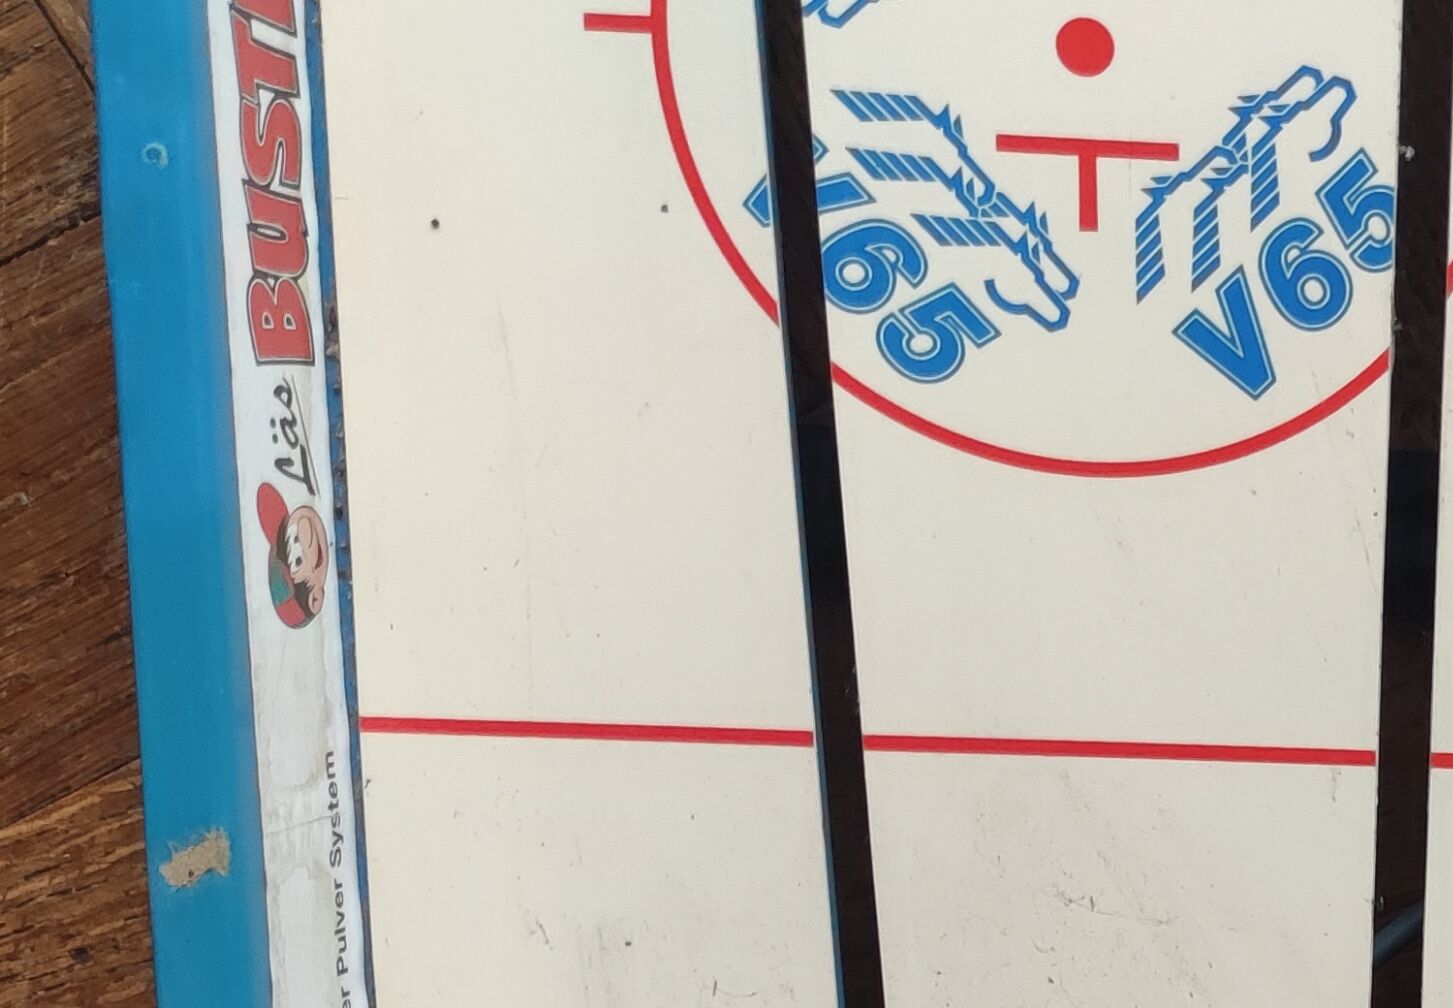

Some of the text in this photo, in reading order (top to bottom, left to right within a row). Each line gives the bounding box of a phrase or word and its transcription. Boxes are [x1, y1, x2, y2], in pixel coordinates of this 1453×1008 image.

[1172, 148, 1396, 401] V65
[272, 378, 318, 496] Läs
[324, 750, 344, 868] System
[333, 878, 348, 976] Pulver
